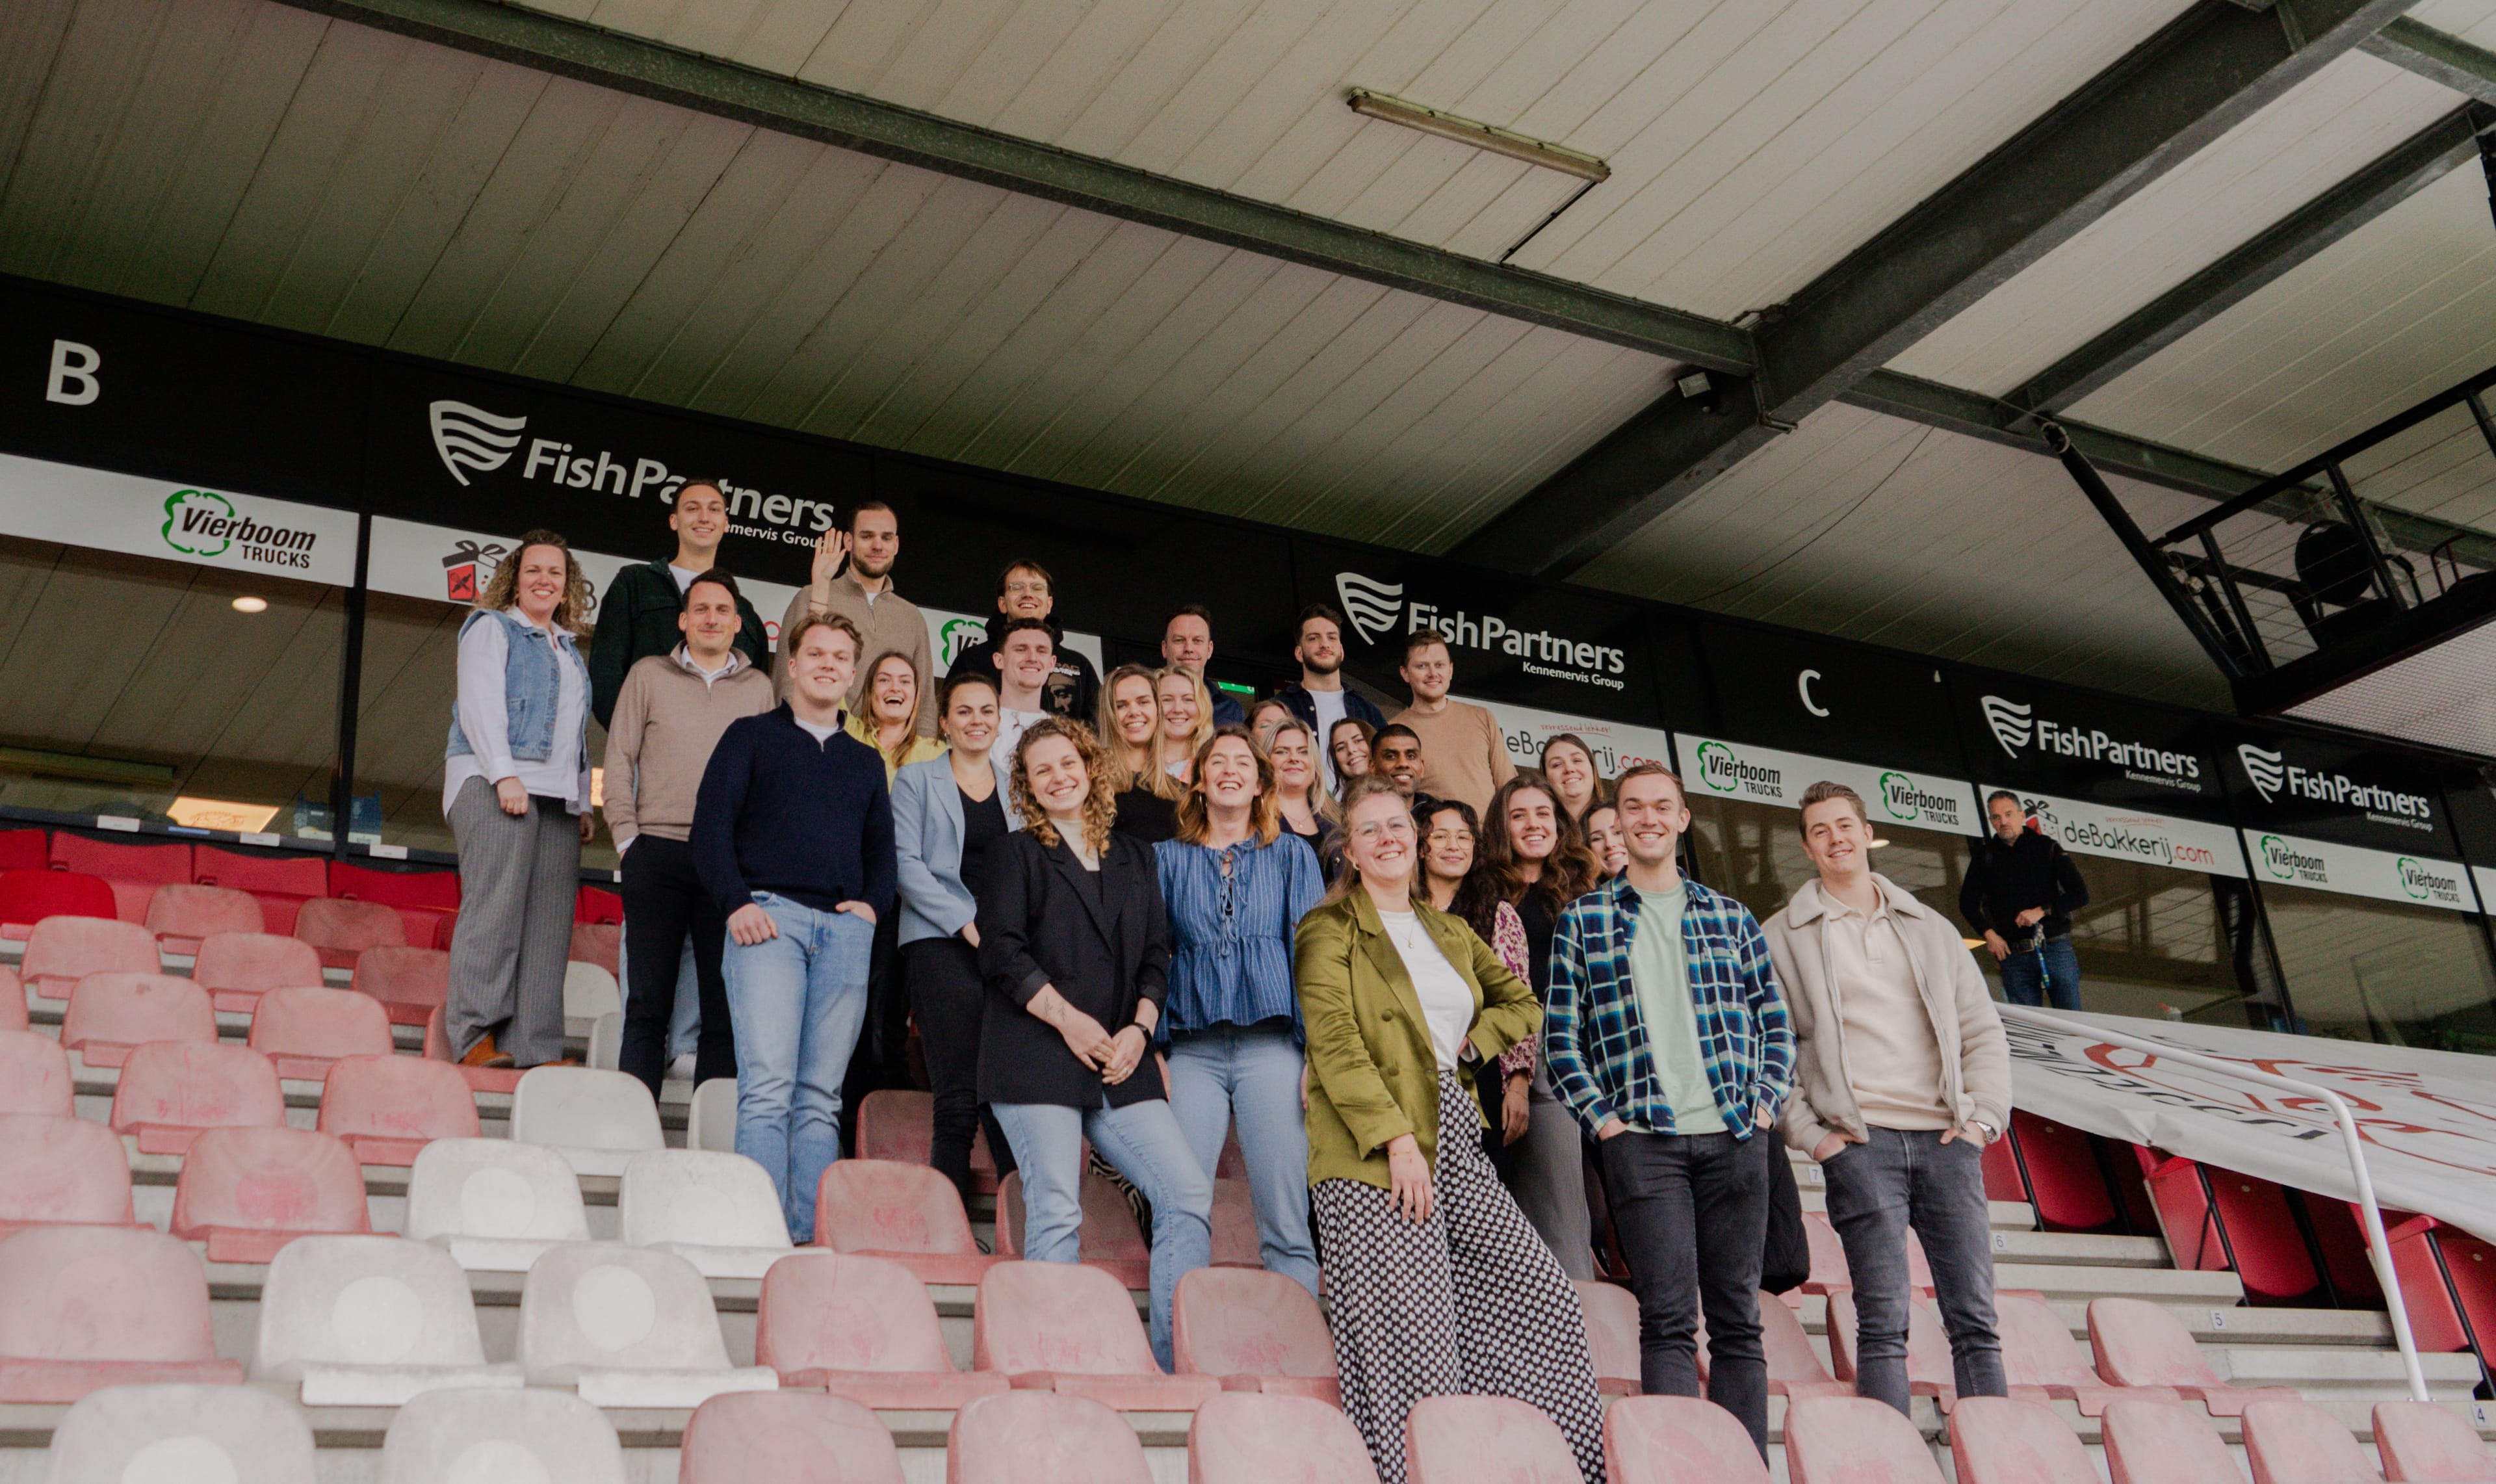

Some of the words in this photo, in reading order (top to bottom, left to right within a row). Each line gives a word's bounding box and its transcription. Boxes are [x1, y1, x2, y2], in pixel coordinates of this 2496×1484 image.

[47, 339, 101, 406] B
[523, 437, 834, 532] FishPatners
[182, 507, 317, 551] Vierboom
[782, 530, 825, 549] Grou
[242, 545, 311, 569] TRUCKS
[1408, 602, 1624, 673] FishPartners
[1523, 661, 1589, 683] Kennemervis
[1591, 673, 1624, 691] Group
[1798, 669, 1830, 717] C
[2037, 720, 2200, 778] FishPartners
[1709, 755, 1781, 785] Vierboom
[1744, 781, 1783, 798] TRUCKS
[1890, 785, 1956, 813] Vierboom
[2287, 766, 2431, 818] FishPartners
[1923, 810, 1959, 826] TRUCKS
[2064, 820, 2215, 866] deBakkerij.com
[2270, 846, 2325, 871] Vierboom
[2406, 868, 2457, 891] Vierboom
[1811, 1169, 1819, 1181] 7
[1996, 1235, 2004, 1248] 6
[2215, 1312, 2223, 1327] 5
[2477, 1408, 2486, 1423] 4
